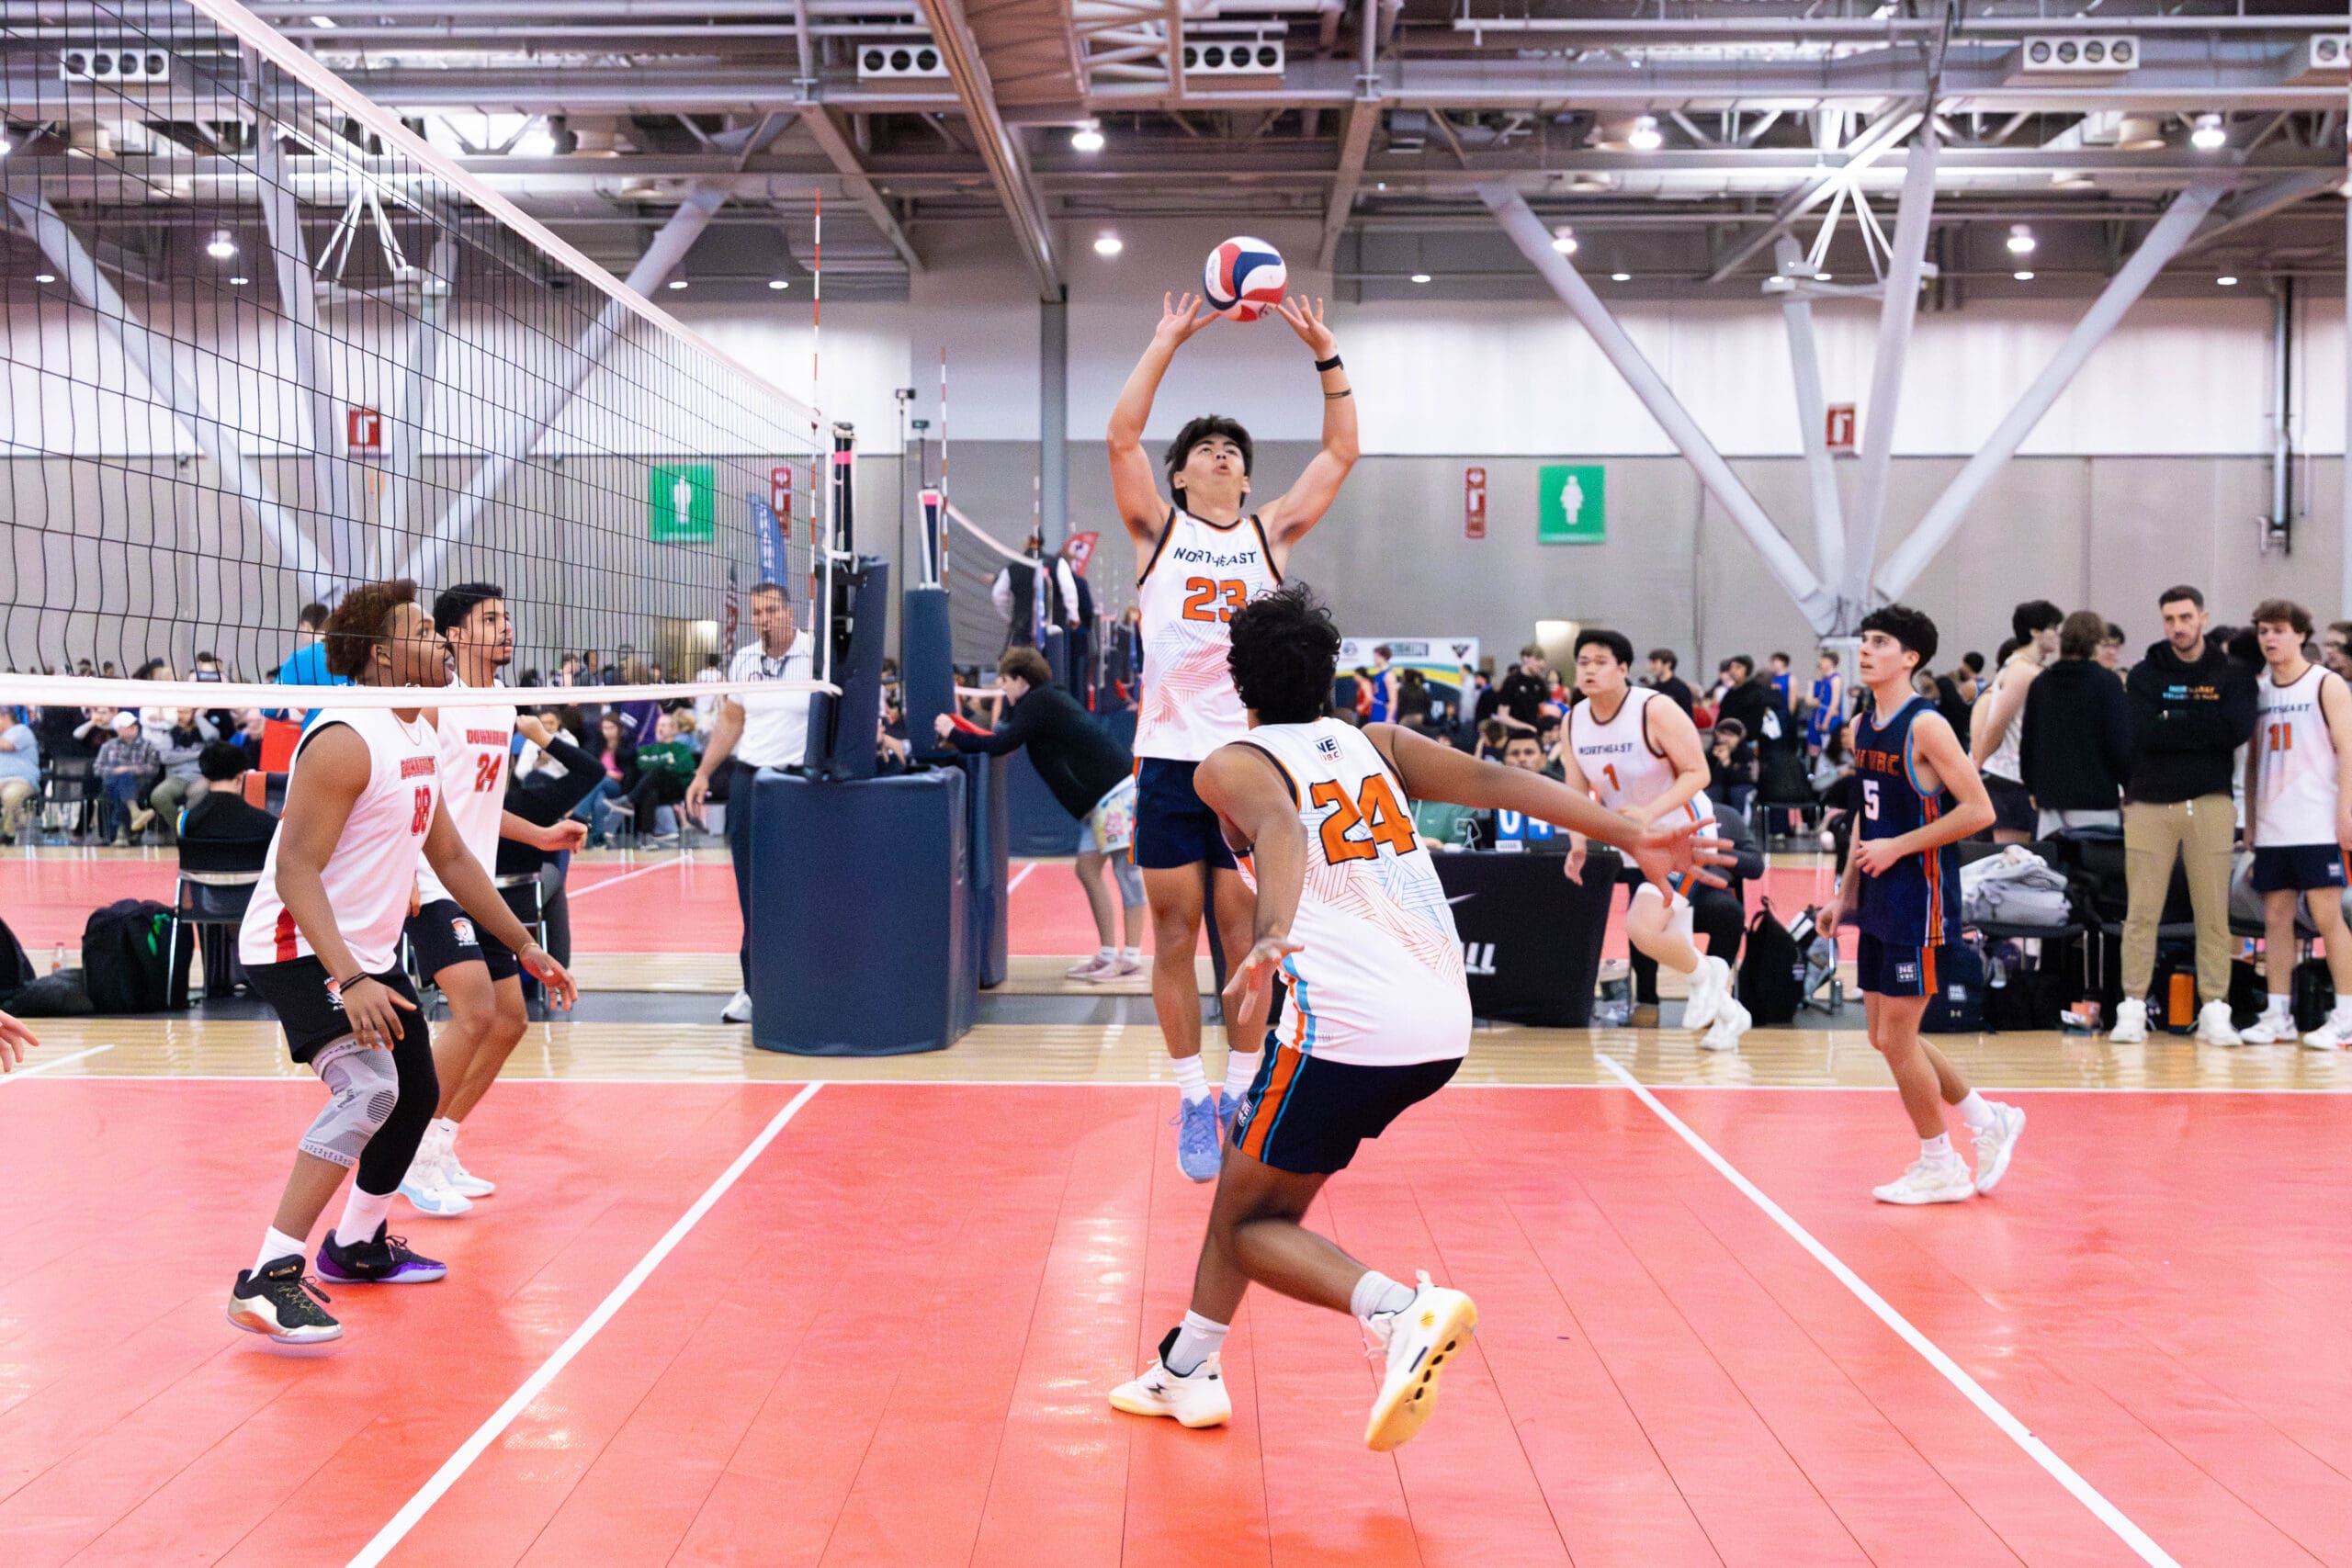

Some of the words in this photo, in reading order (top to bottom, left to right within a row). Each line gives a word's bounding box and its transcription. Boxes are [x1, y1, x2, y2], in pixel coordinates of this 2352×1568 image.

[1173, 547, 1256, 567] NORTHEAST
[1182, 576, 1249, 624] 23
[1578, 741, 1634, 755] NORTHEAST
[2268, 721, 2292, 751] 11
[473, 752, 503, 793] 24
[1602, 762, 1621, 792] 1
[1862, 778, 1880, 822] 5
[1308, 773, 1418, 866] 24
